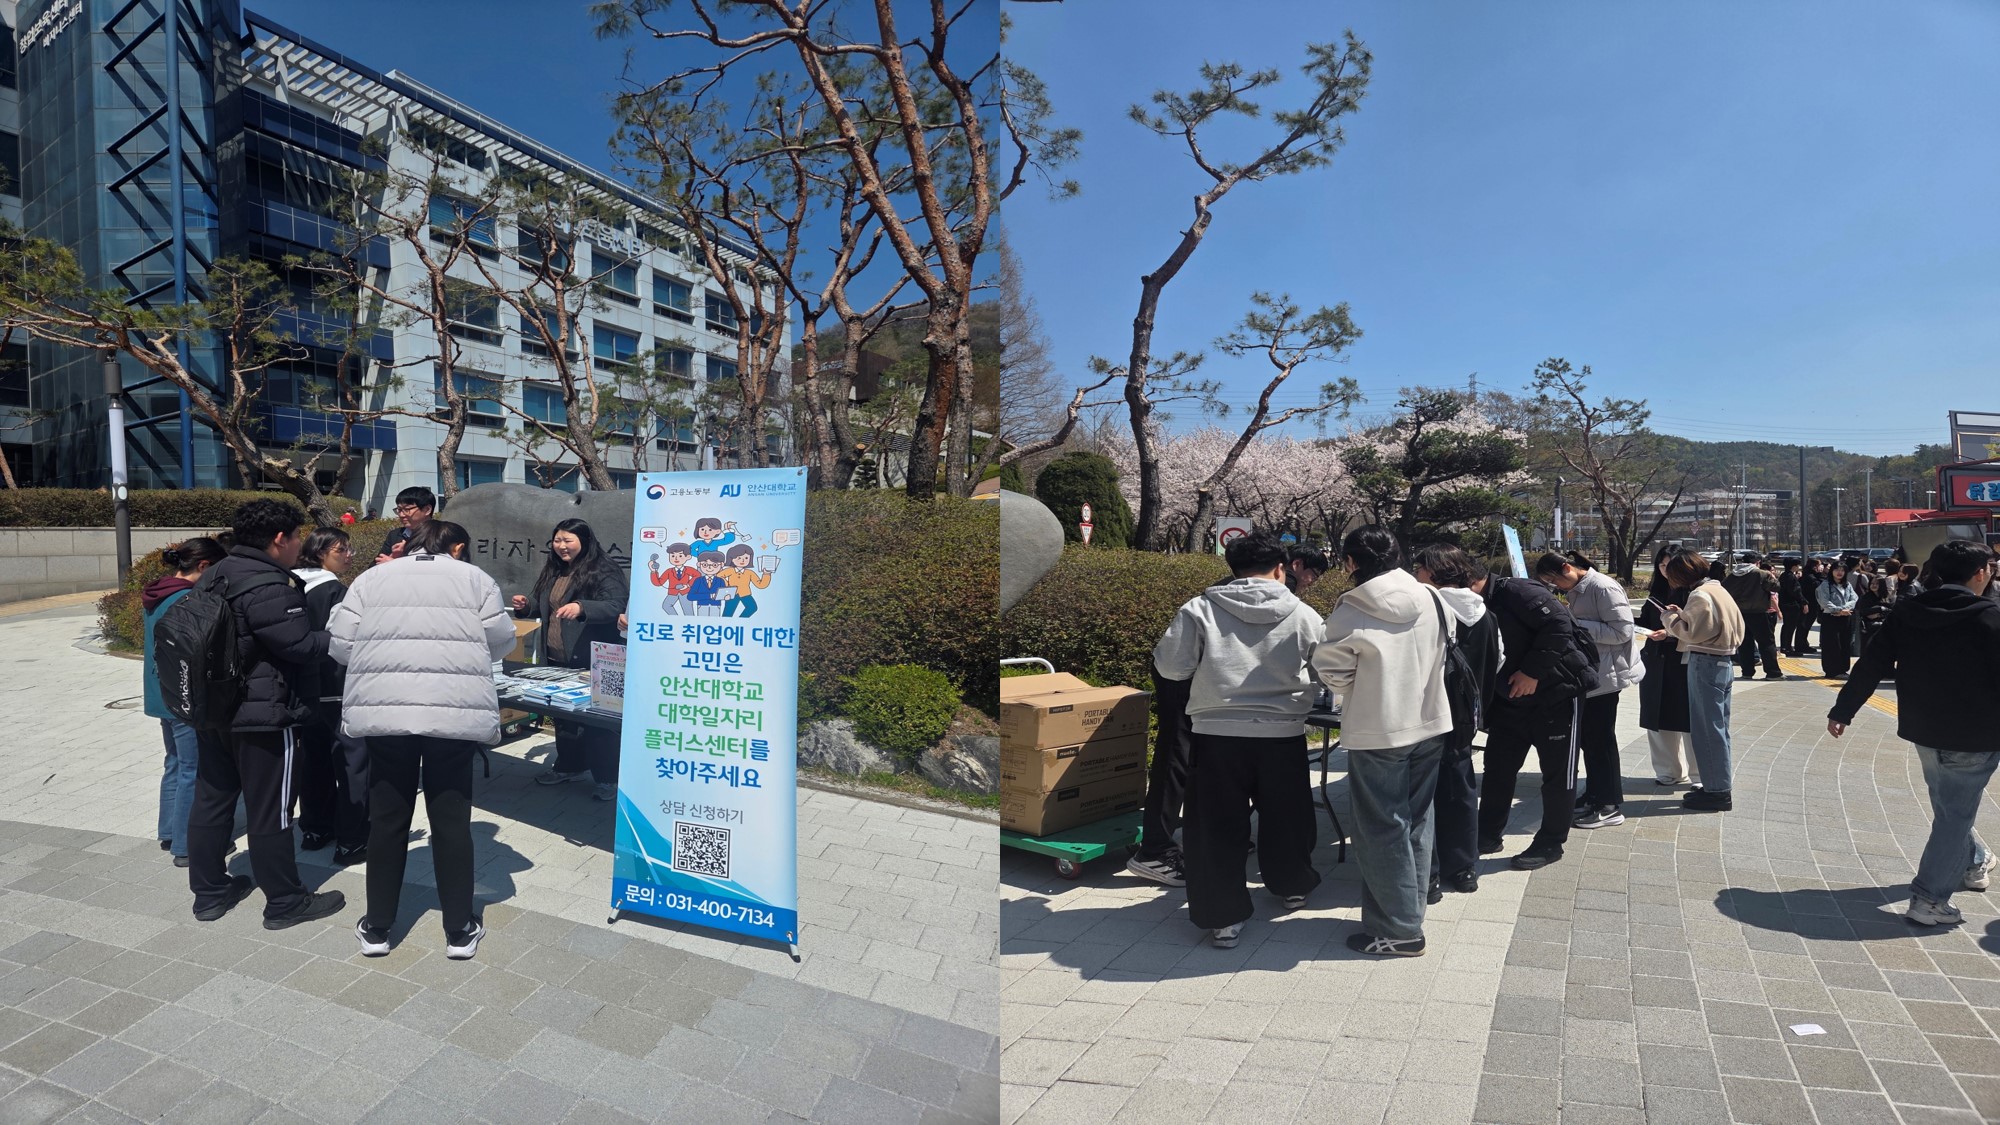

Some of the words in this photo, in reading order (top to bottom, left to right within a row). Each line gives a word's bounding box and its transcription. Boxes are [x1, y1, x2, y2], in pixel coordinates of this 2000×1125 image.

[669, 487, 711, 497] 고용노동부
[747, 483, 797, 493] 안산대학교
[635, 622, 674, 642] 진로
[681, 624, 744, 647] 취업에
[752, 626, 795, 649] 대한
[681, 651, 743, 673] 고민은
[659, 676, 764, 701] 안산대학교
[658, 703, 763, 732] 대학일자리
[1081, 717, 1101, 727] HANDY
[1083, 707, 1114, 718] PORTABLE
[644, 728, 770, 762] 플러스센터를
[655, 757, 762, 788] 찾아주세요
[659, 800, 686, 816] 상담
[690, 803, 744, 825] 신청하기
[625, 884, 655, 906] 문의
[666, 893, 775, 928] 031-400-7134
